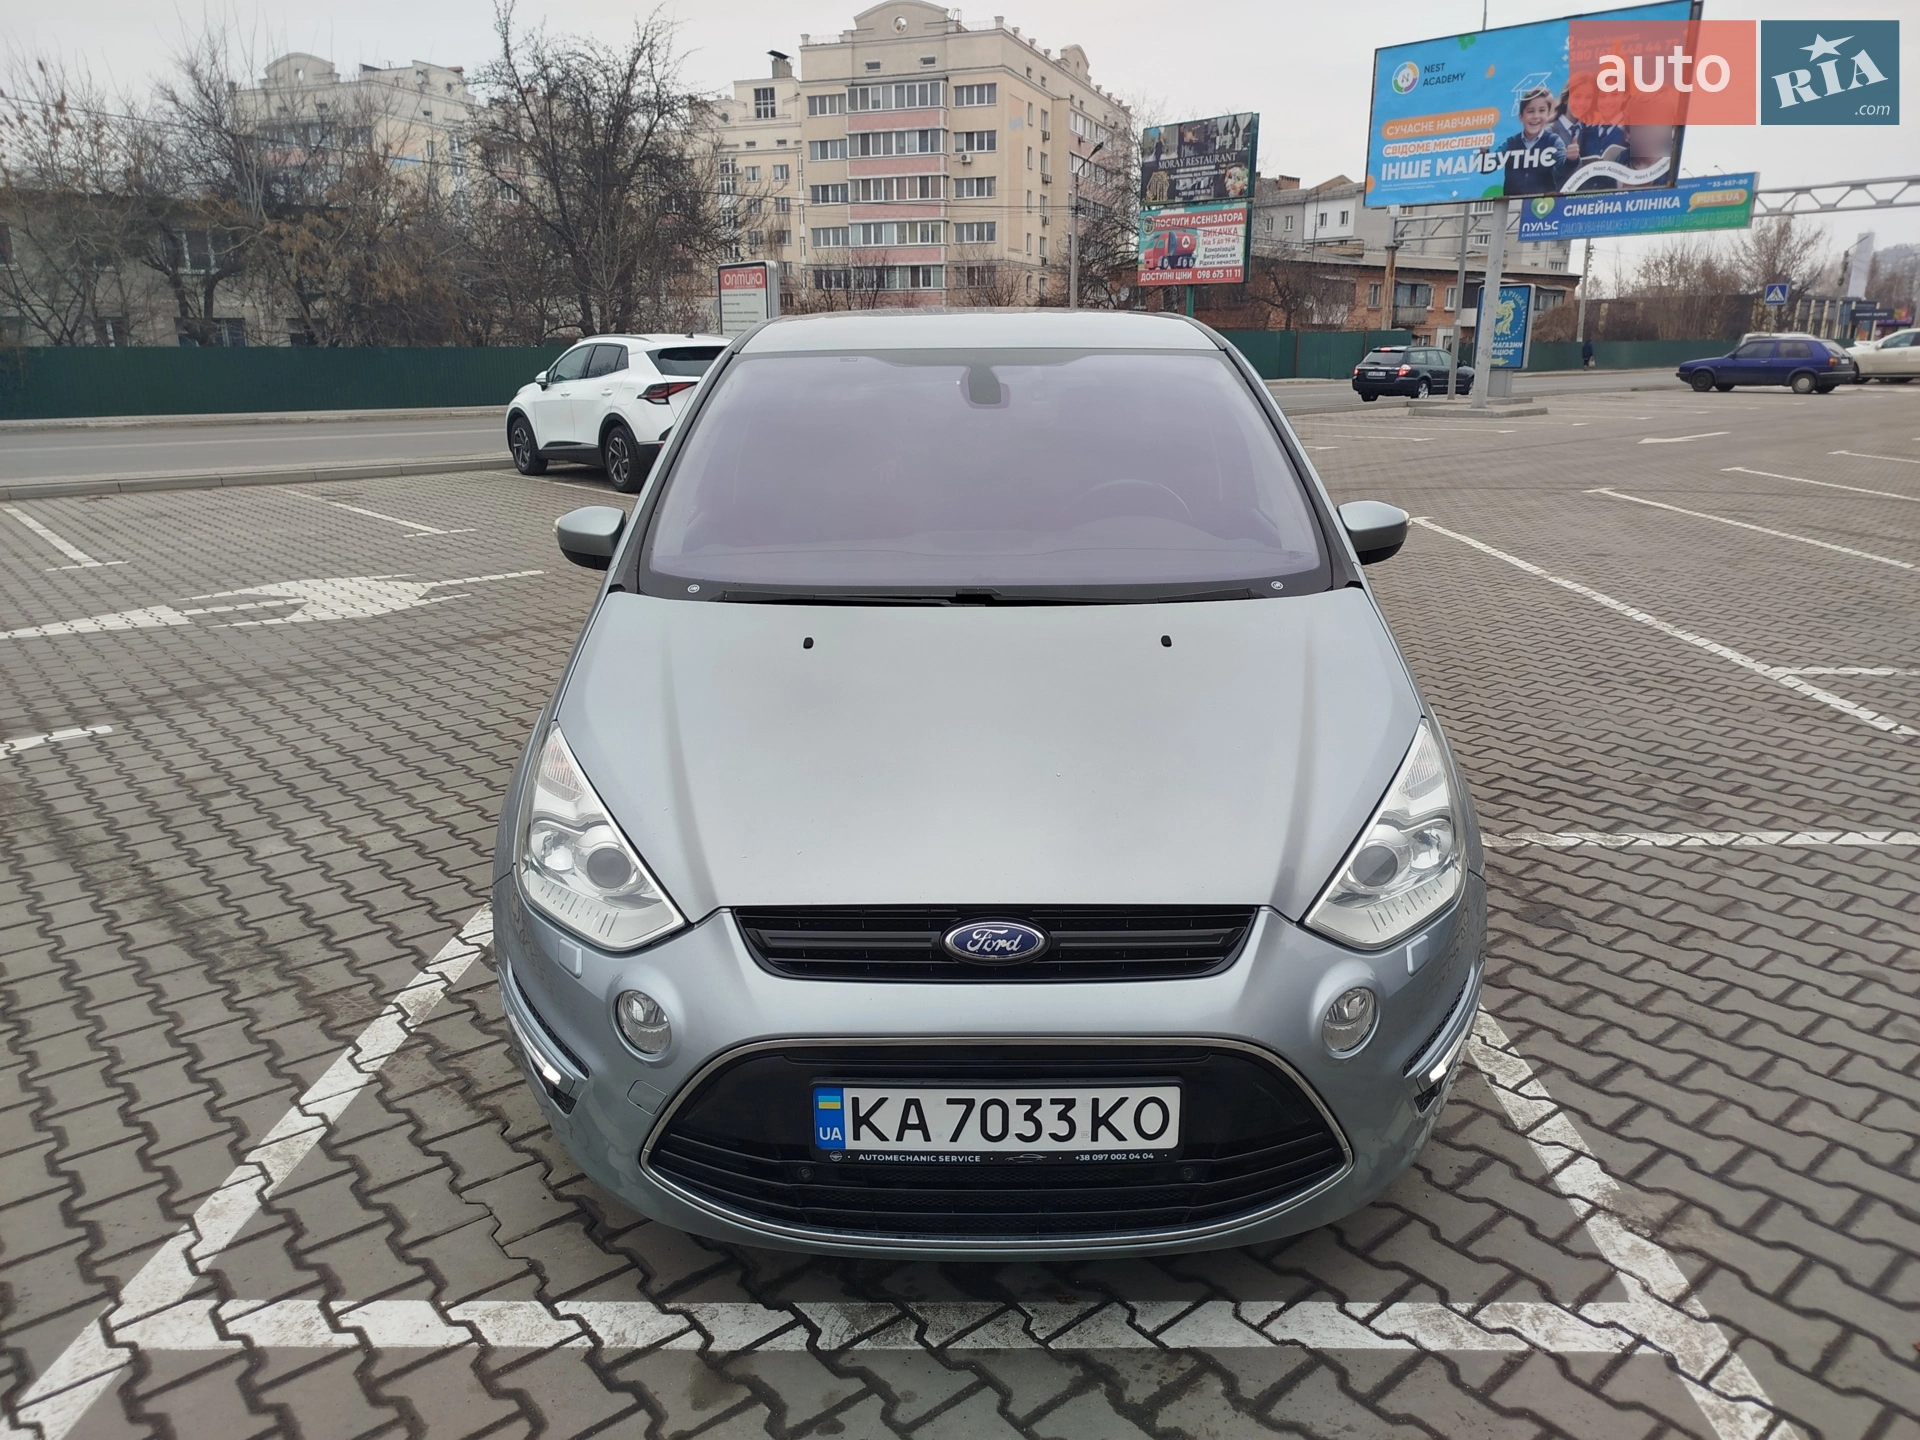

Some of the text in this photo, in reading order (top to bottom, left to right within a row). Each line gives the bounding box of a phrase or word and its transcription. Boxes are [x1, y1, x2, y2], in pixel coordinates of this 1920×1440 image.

[1424, 62, 1446, 74] NEST
[1423, 72, 1466, 87] ACADEMY
[1386, 113, 1495, 136] СУЧАСНЕ НАВЧАННЯ
[1384, 134, 1493, 156] СВІДОМЕ МИСЛЕННЯ
[1158, 157, 1185, 170] MORAY
[1186, 151, 1238, 167] RESTAURANT
[1381, 147, 1557, 181] ІНШЕ МАЙБУТНЄ
[1696, 193, 1740, 203] PULS.UA
[1563, 196, 1681, 217] СІМЕЙНА КЛІНІКА
[1155, 212, 1243, 229] ПОСЛУГИ АСЕНІЗАТОРА
[1522, 221, 1559, 232] ПУЛЬС
[1203, 227, 1239, 238] ВИКАЧКА
[1141, 271, 1174, 282] ДОСТУПНІ
[1175, 270, 1192, 281] ЦІНИ
[1197, 270, 1211, 279] 098
[1212, 270, 1224, 278] 675
[966, 928, 1022, 952] Ford
[851, 1096, 1170, 1143] KA 7033 KO
[819, 1127, 842, 1141] UA
[858, 1153, 981, 1163] AUTOMECHANIC SERVICE
[1092, 1153, 1108, 1161] 097
[1109, 1153, 1126, 1161] 002
[1142, 1152, 1154, 1160] 04
